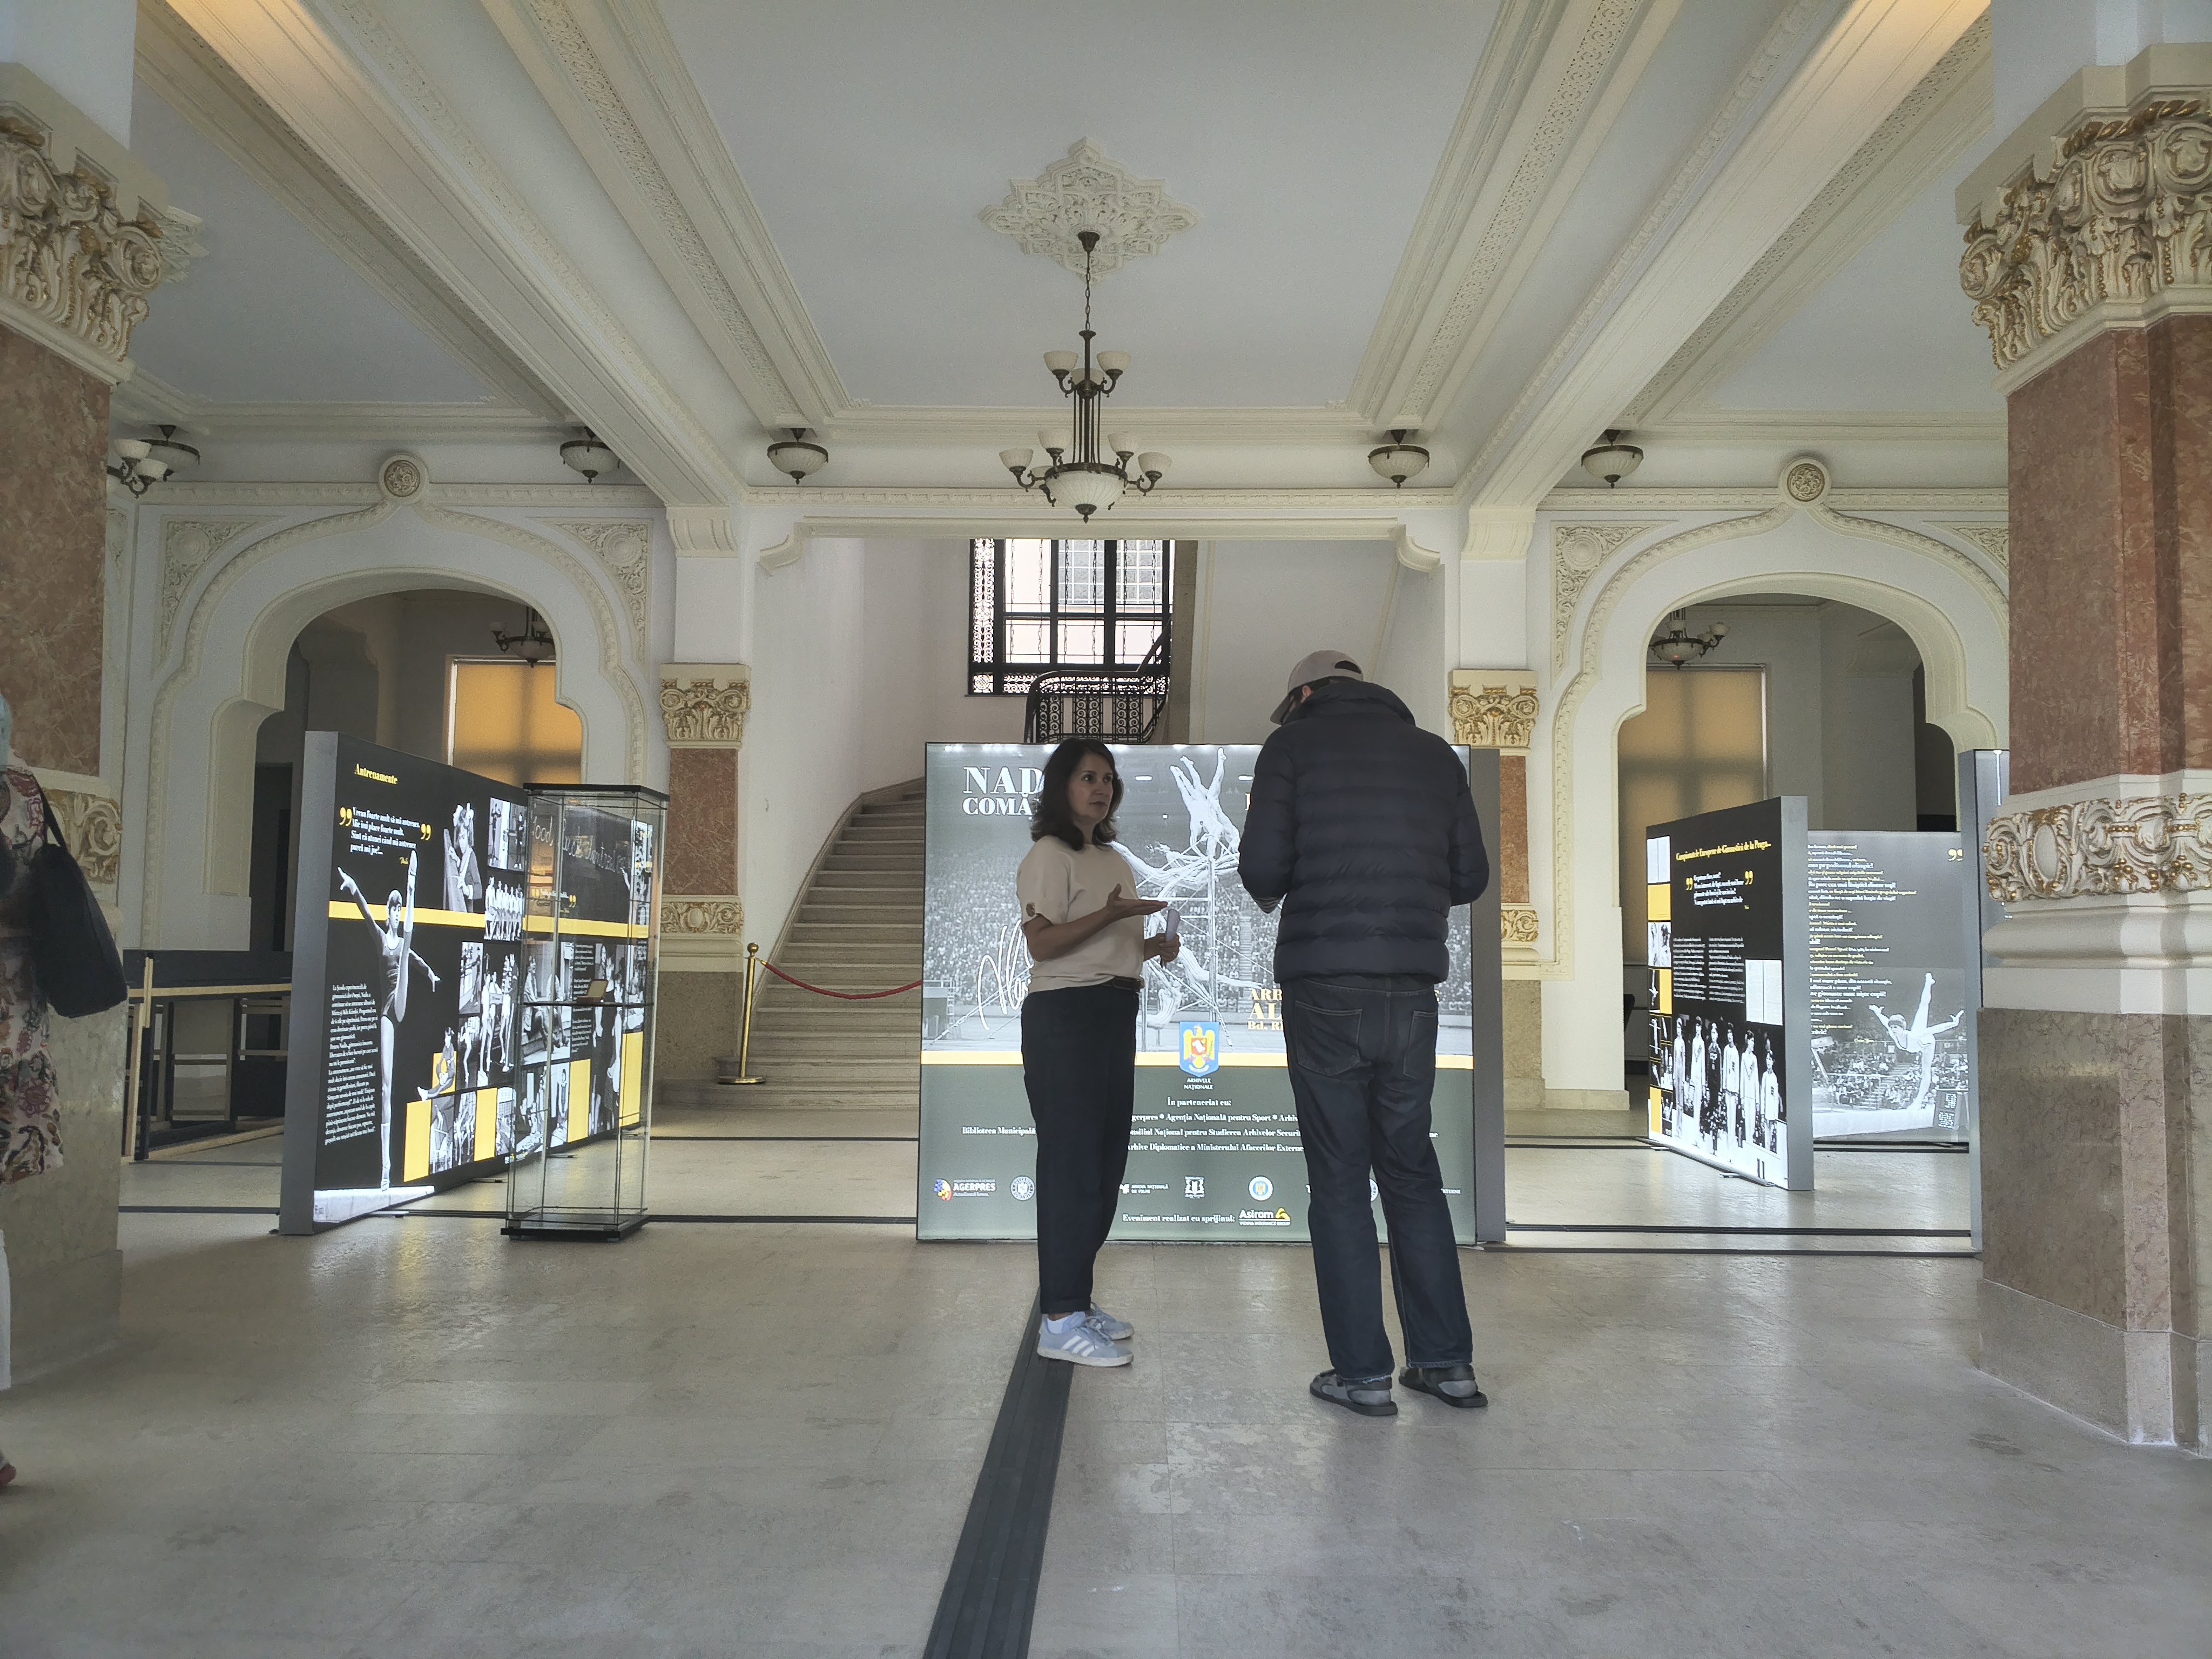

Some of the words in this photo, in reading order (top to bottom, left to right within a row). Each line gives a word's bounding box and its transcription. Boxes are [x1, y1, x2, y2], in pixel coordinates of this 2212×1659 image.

[354, 763, 398, 785] Antrenamente
[963, 767, 1045, 794] NAD
[962, 793, 1034, 815] COMĂ
[353, 806, 366, 817] Vreau
[367, 810, 380, 820] foarte
[380, 814, 390, 822] mult
[368, 821, 380, 832] place
[380, 824, 393, 834] foarte
[1248, 1021, 1268, 1030] Bd.
[1168, 1096, 1176, 1105] În
[1177, 1098, 1218, 1107] parteneriat
[1165, 1114, 1192, 1122] Agenția
[1193, 1113, 1226, 1122] Națională
[1228, 1115, 1251, 1123] pentru
[1252, 1114, 1271, 1123] Sport
[997, 1127, 1036, 1136] Municipală
[1154, 1128, 1183, 1137] Național
[1149, 1143, 1190, 1152] Diplomatice
[953, 1183, 996, 1191] AGERPRES
[1239, 1209, 1274, 1219] Asirom
[1202, 1215, 1235, 1224] sprijinul:
